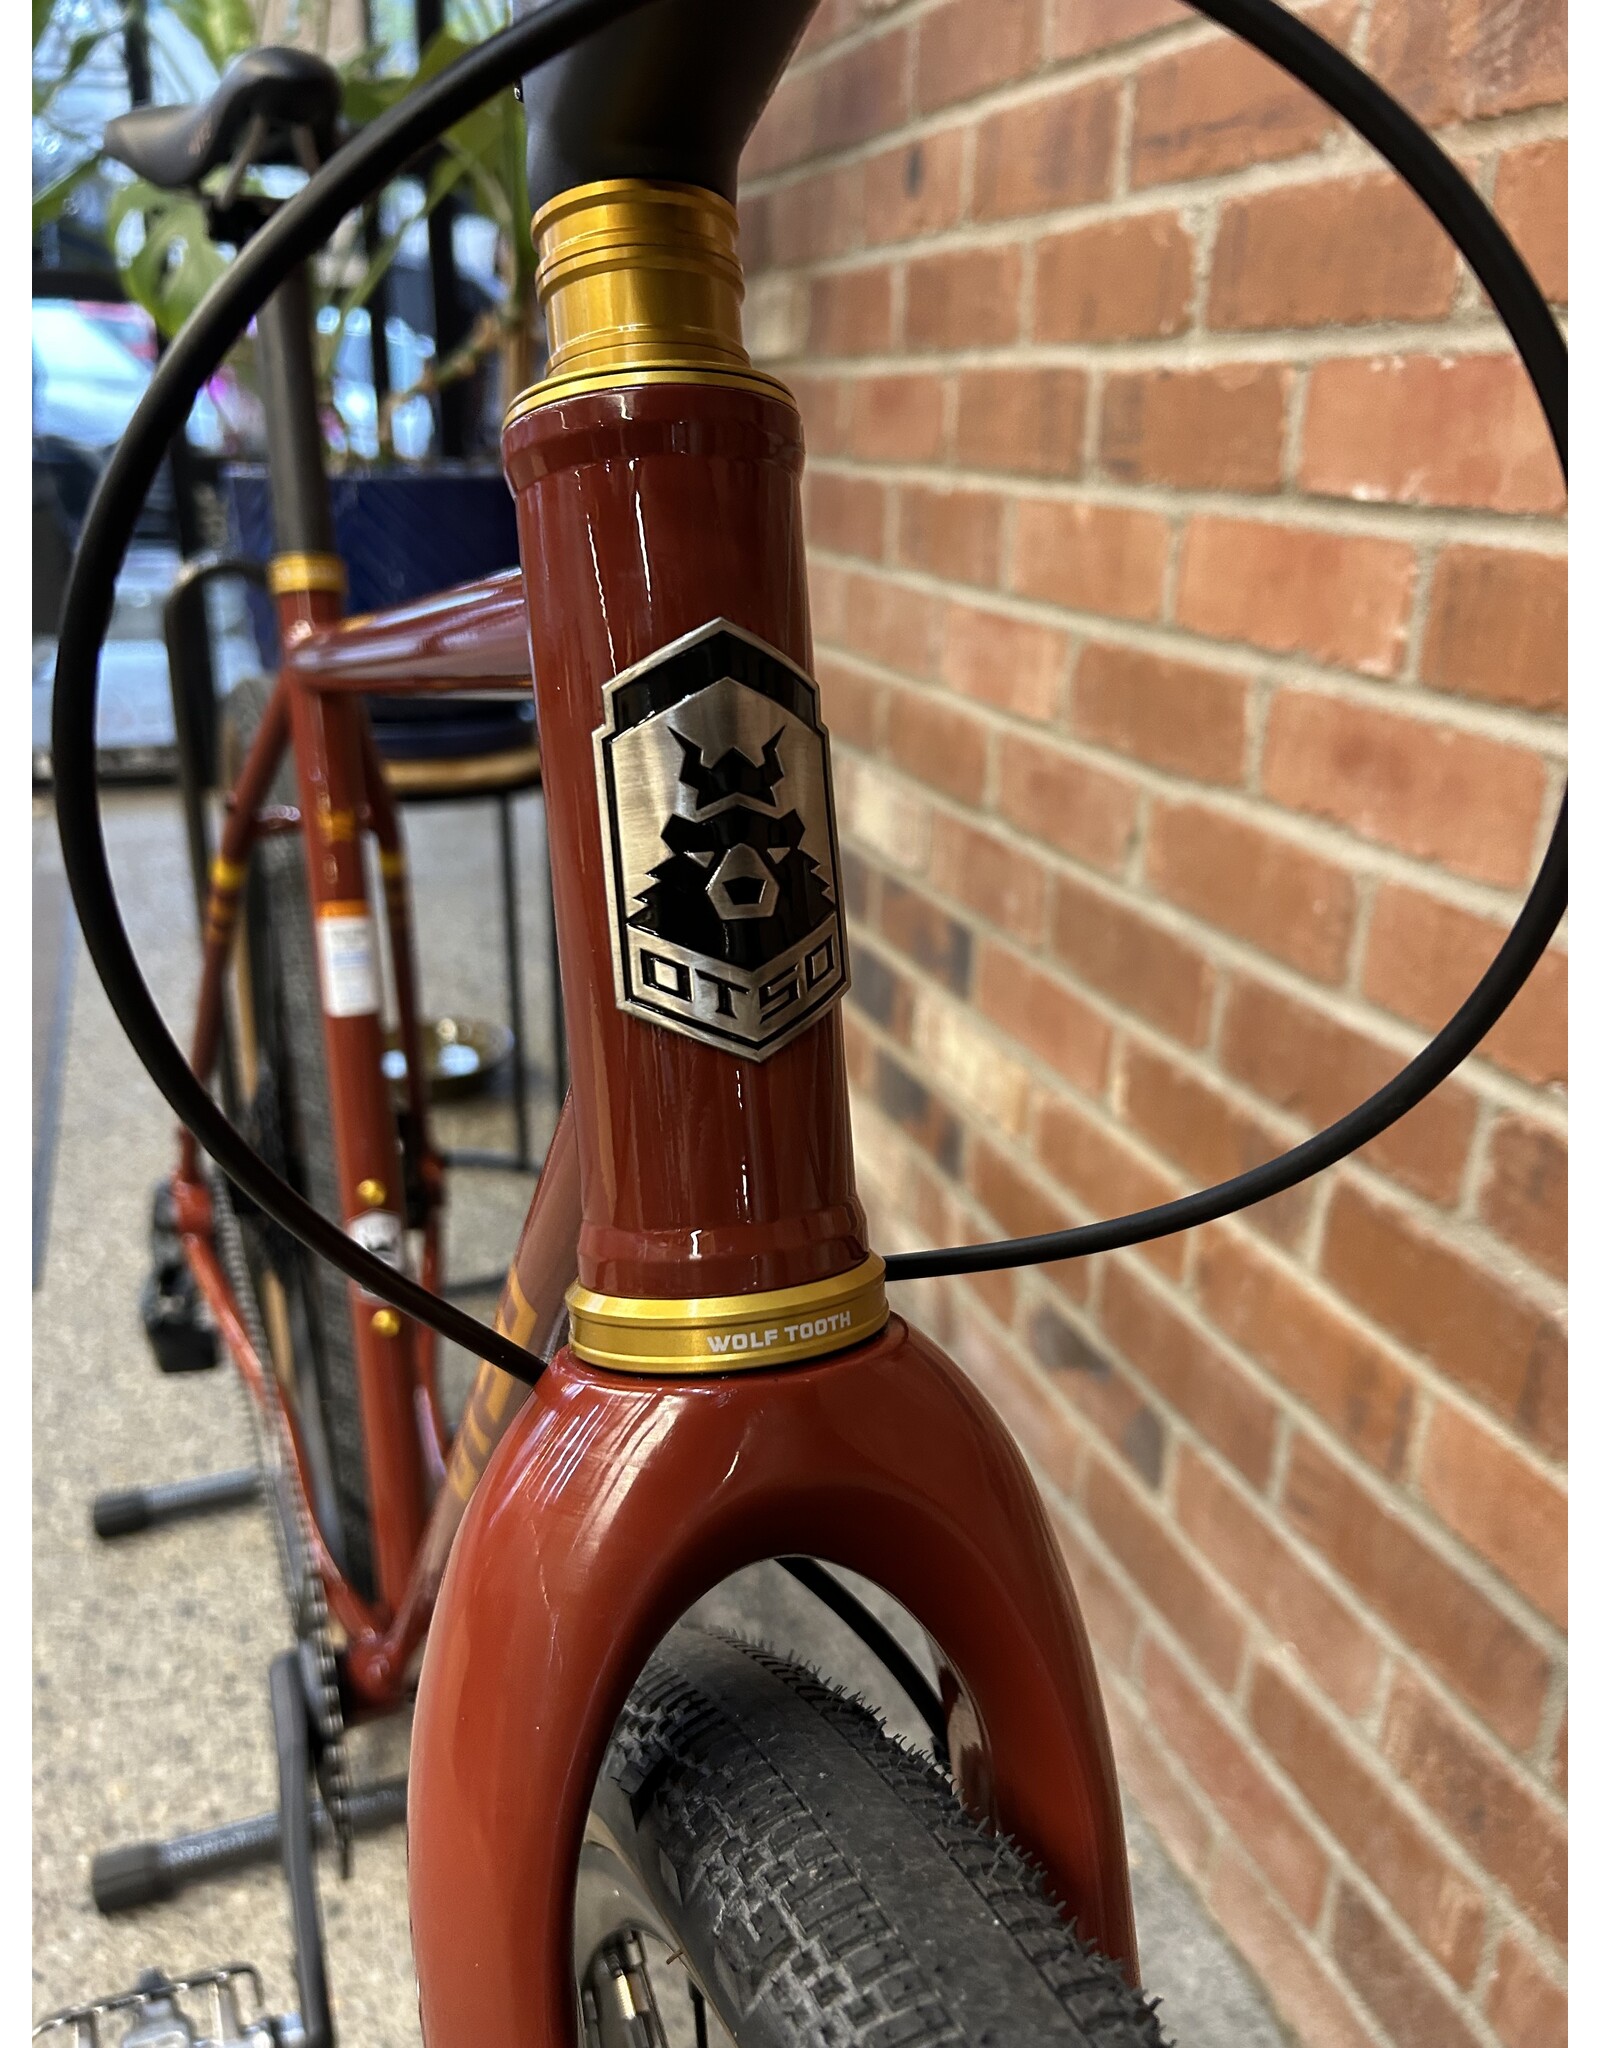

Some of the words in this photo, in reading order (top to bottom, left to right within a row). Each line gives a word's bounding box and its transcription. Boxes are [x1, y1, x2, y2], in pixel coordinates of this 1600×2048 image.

[640, 934, 835, 1025] OTSO
[706, 1329, 778, 1352] WOLF
[784, 1311, 851, 1342] TOOTH
